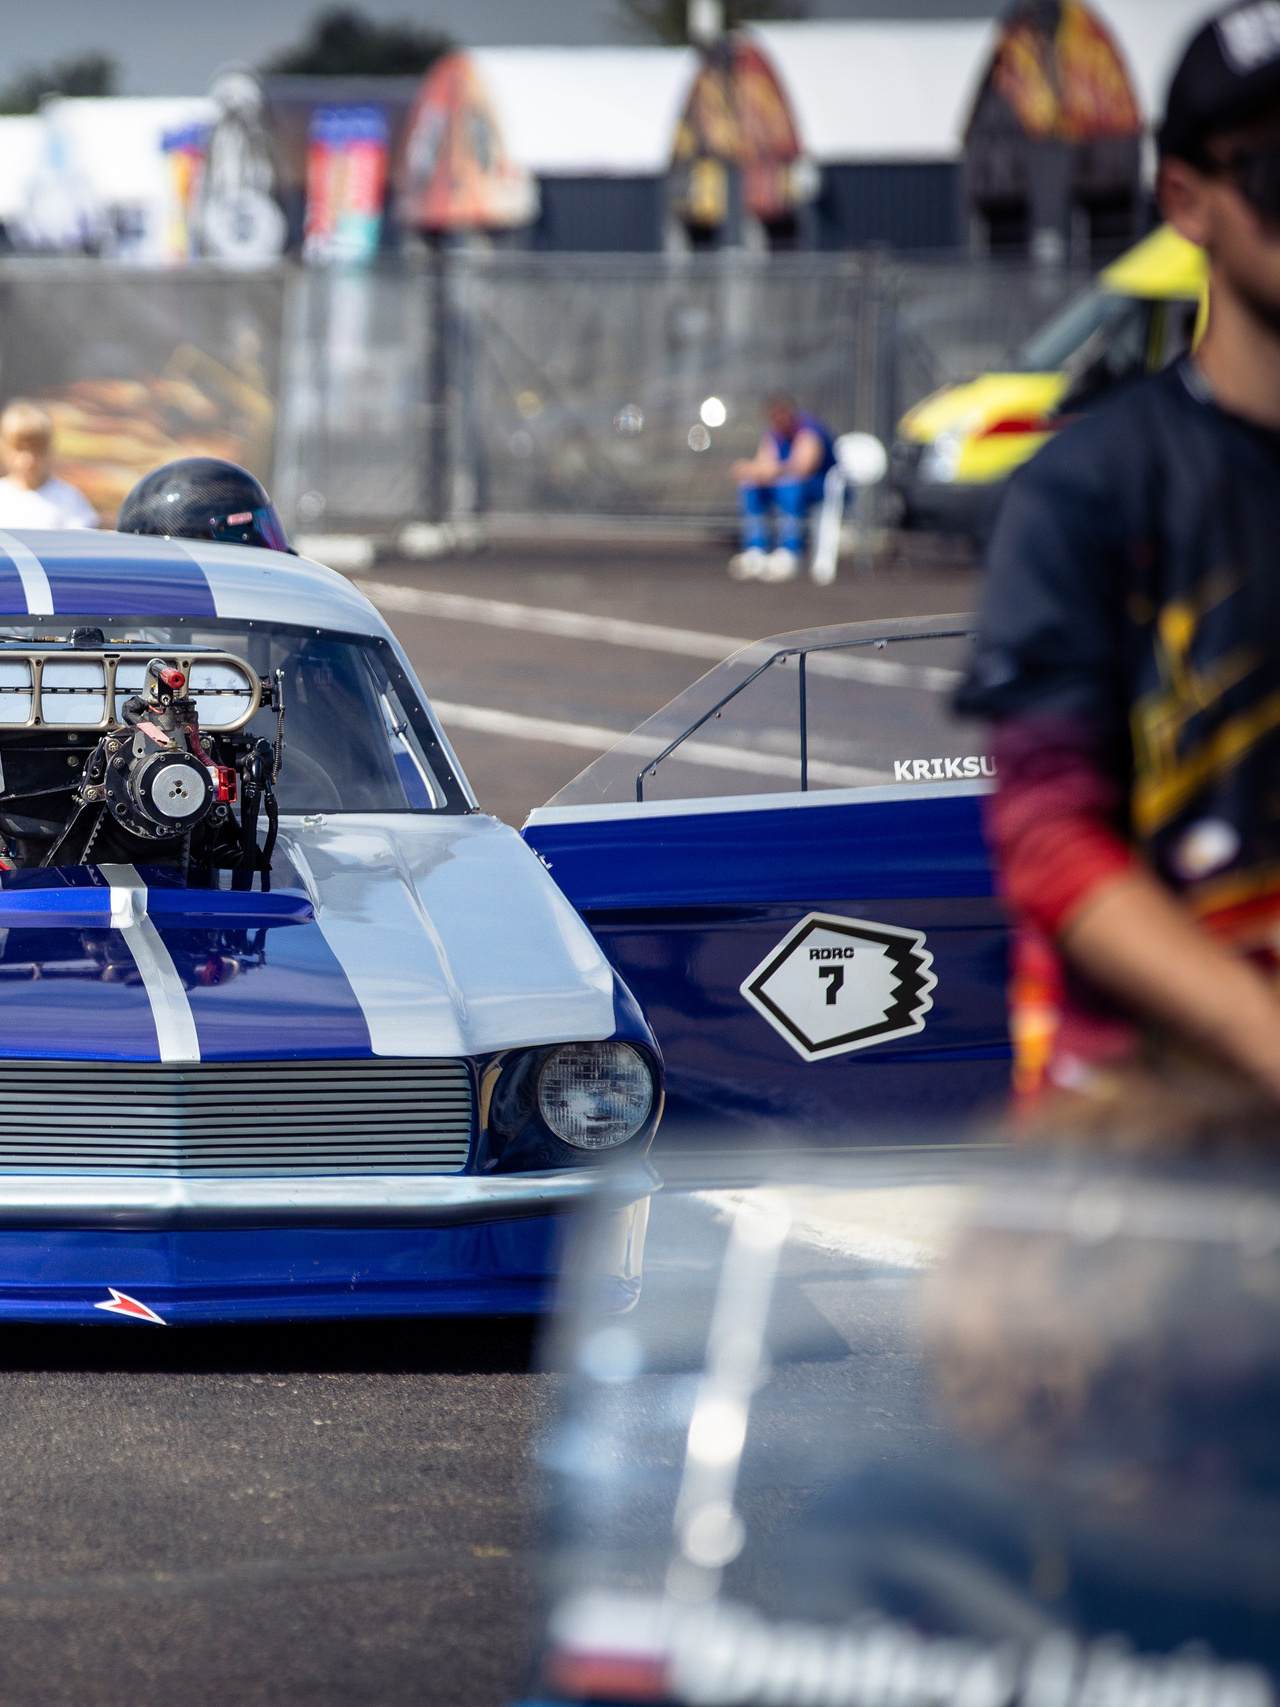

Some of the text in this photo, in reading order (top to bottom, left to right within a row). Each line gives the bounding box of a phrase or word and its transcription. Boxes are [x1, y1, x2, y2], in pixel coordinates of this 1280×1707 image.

[893, 755, 998, 781] KRIKSU
[809, 946, 855, 960] RDRC
[818, 965, 845, 1005] 7
